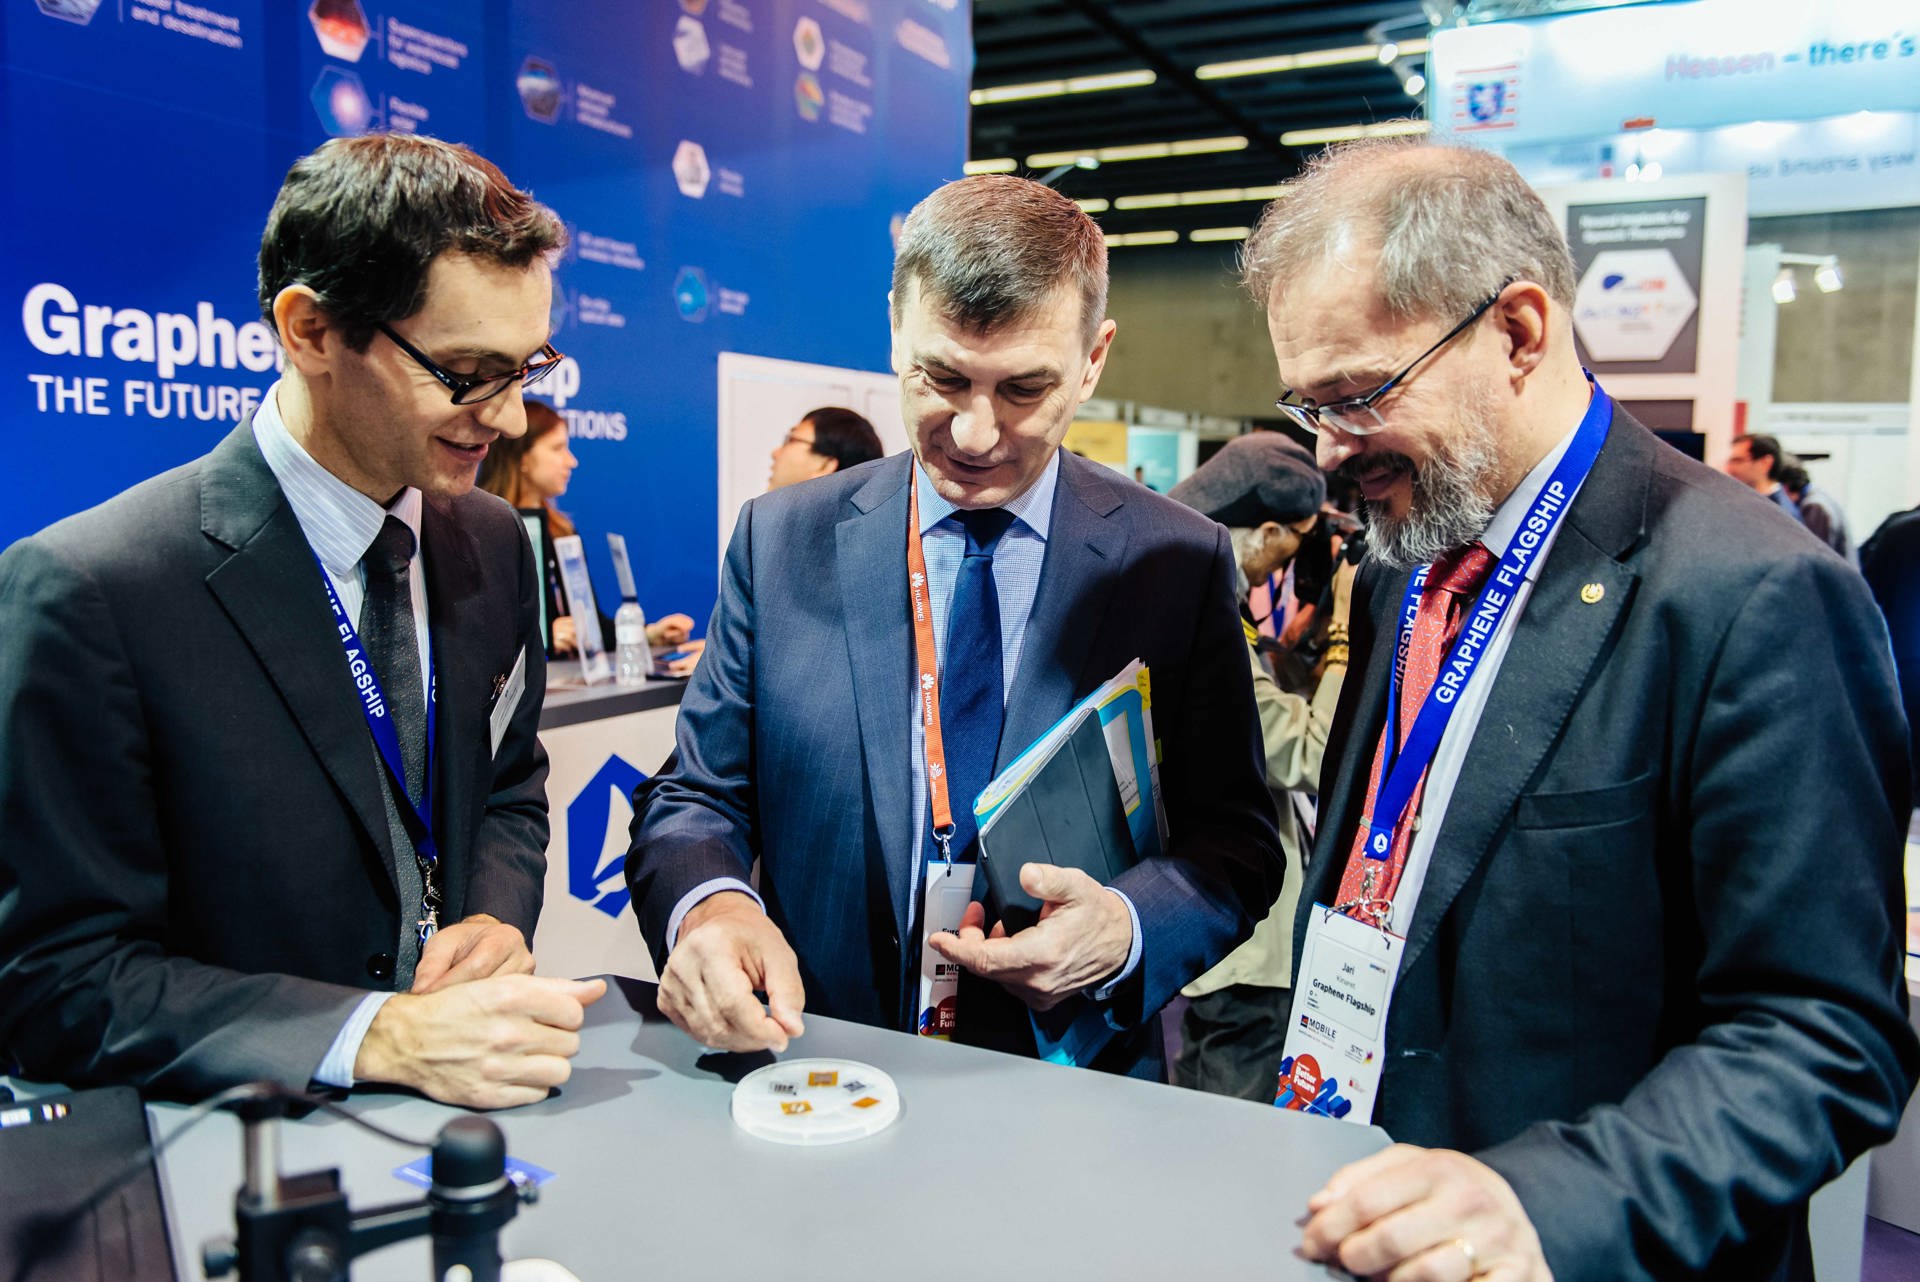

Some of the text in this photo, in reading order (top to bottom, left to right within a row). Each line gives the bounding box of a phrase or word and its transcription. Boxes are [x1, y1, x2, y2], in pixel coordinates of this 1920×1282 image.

[1665, 53, 1774, 82] Hessen
[28, 374, 628, 442] THE FUTURE TIONS
[914, 589, 925, 622] HUAWEI
[1434, 481, 1567, 704] GRAPHENE FLAGSHIP
[925, 691, 933, 726] HUAWEI
[1341, 962, 1355, 976] Jari
[1312, 978, 1345, 1001] Graphene
[1345, 993, 1376, 1016] Flagship
[1309, 1018, 1336, 1039] MOBILE
